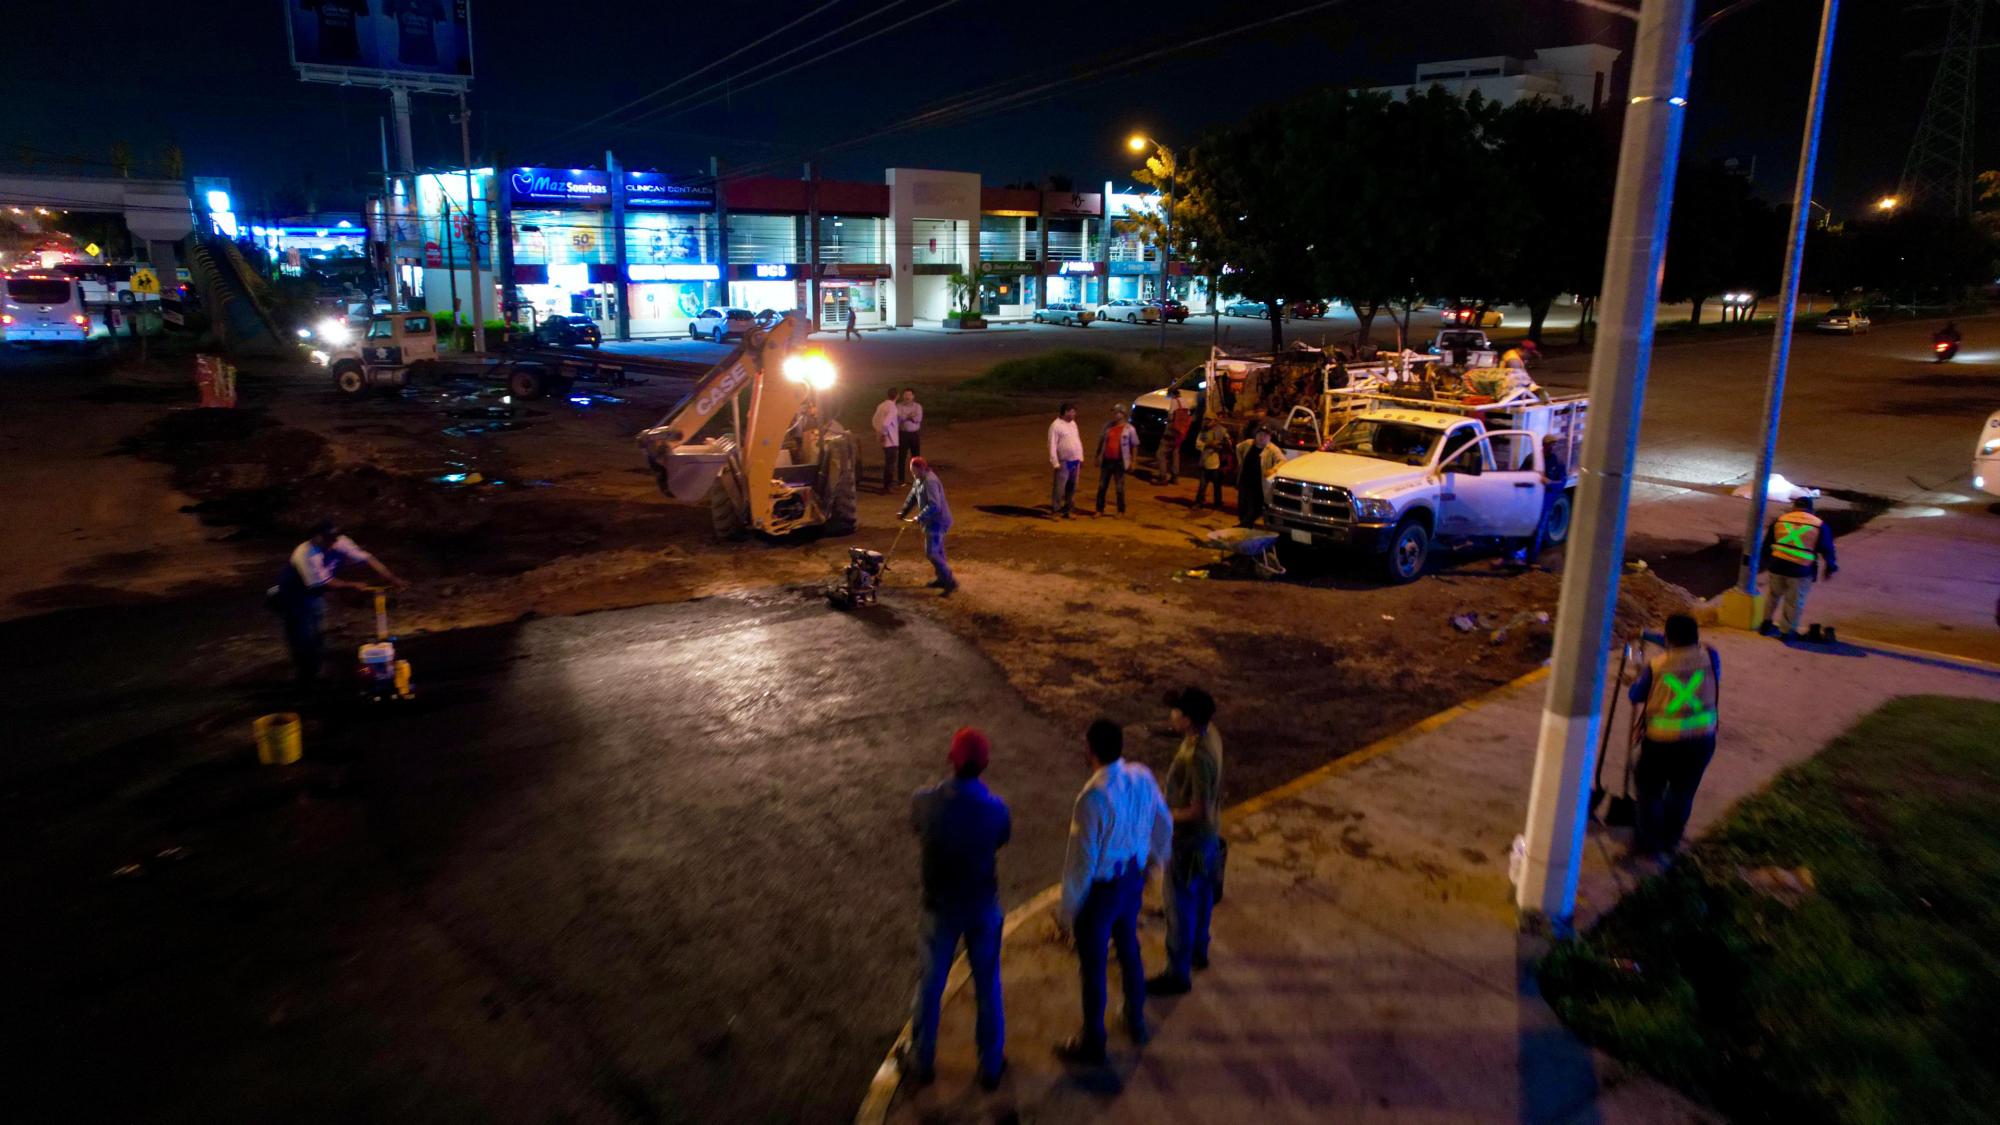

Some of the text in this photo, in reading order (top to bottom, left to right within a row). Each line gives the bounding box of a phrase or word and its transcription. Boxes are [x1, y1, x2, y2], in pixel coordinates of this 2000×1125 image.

[534, 177, 607, 194] Maz Sonrisas
[573, 233, 589, 247] 50
[696, 363, 747, 416] CASE
